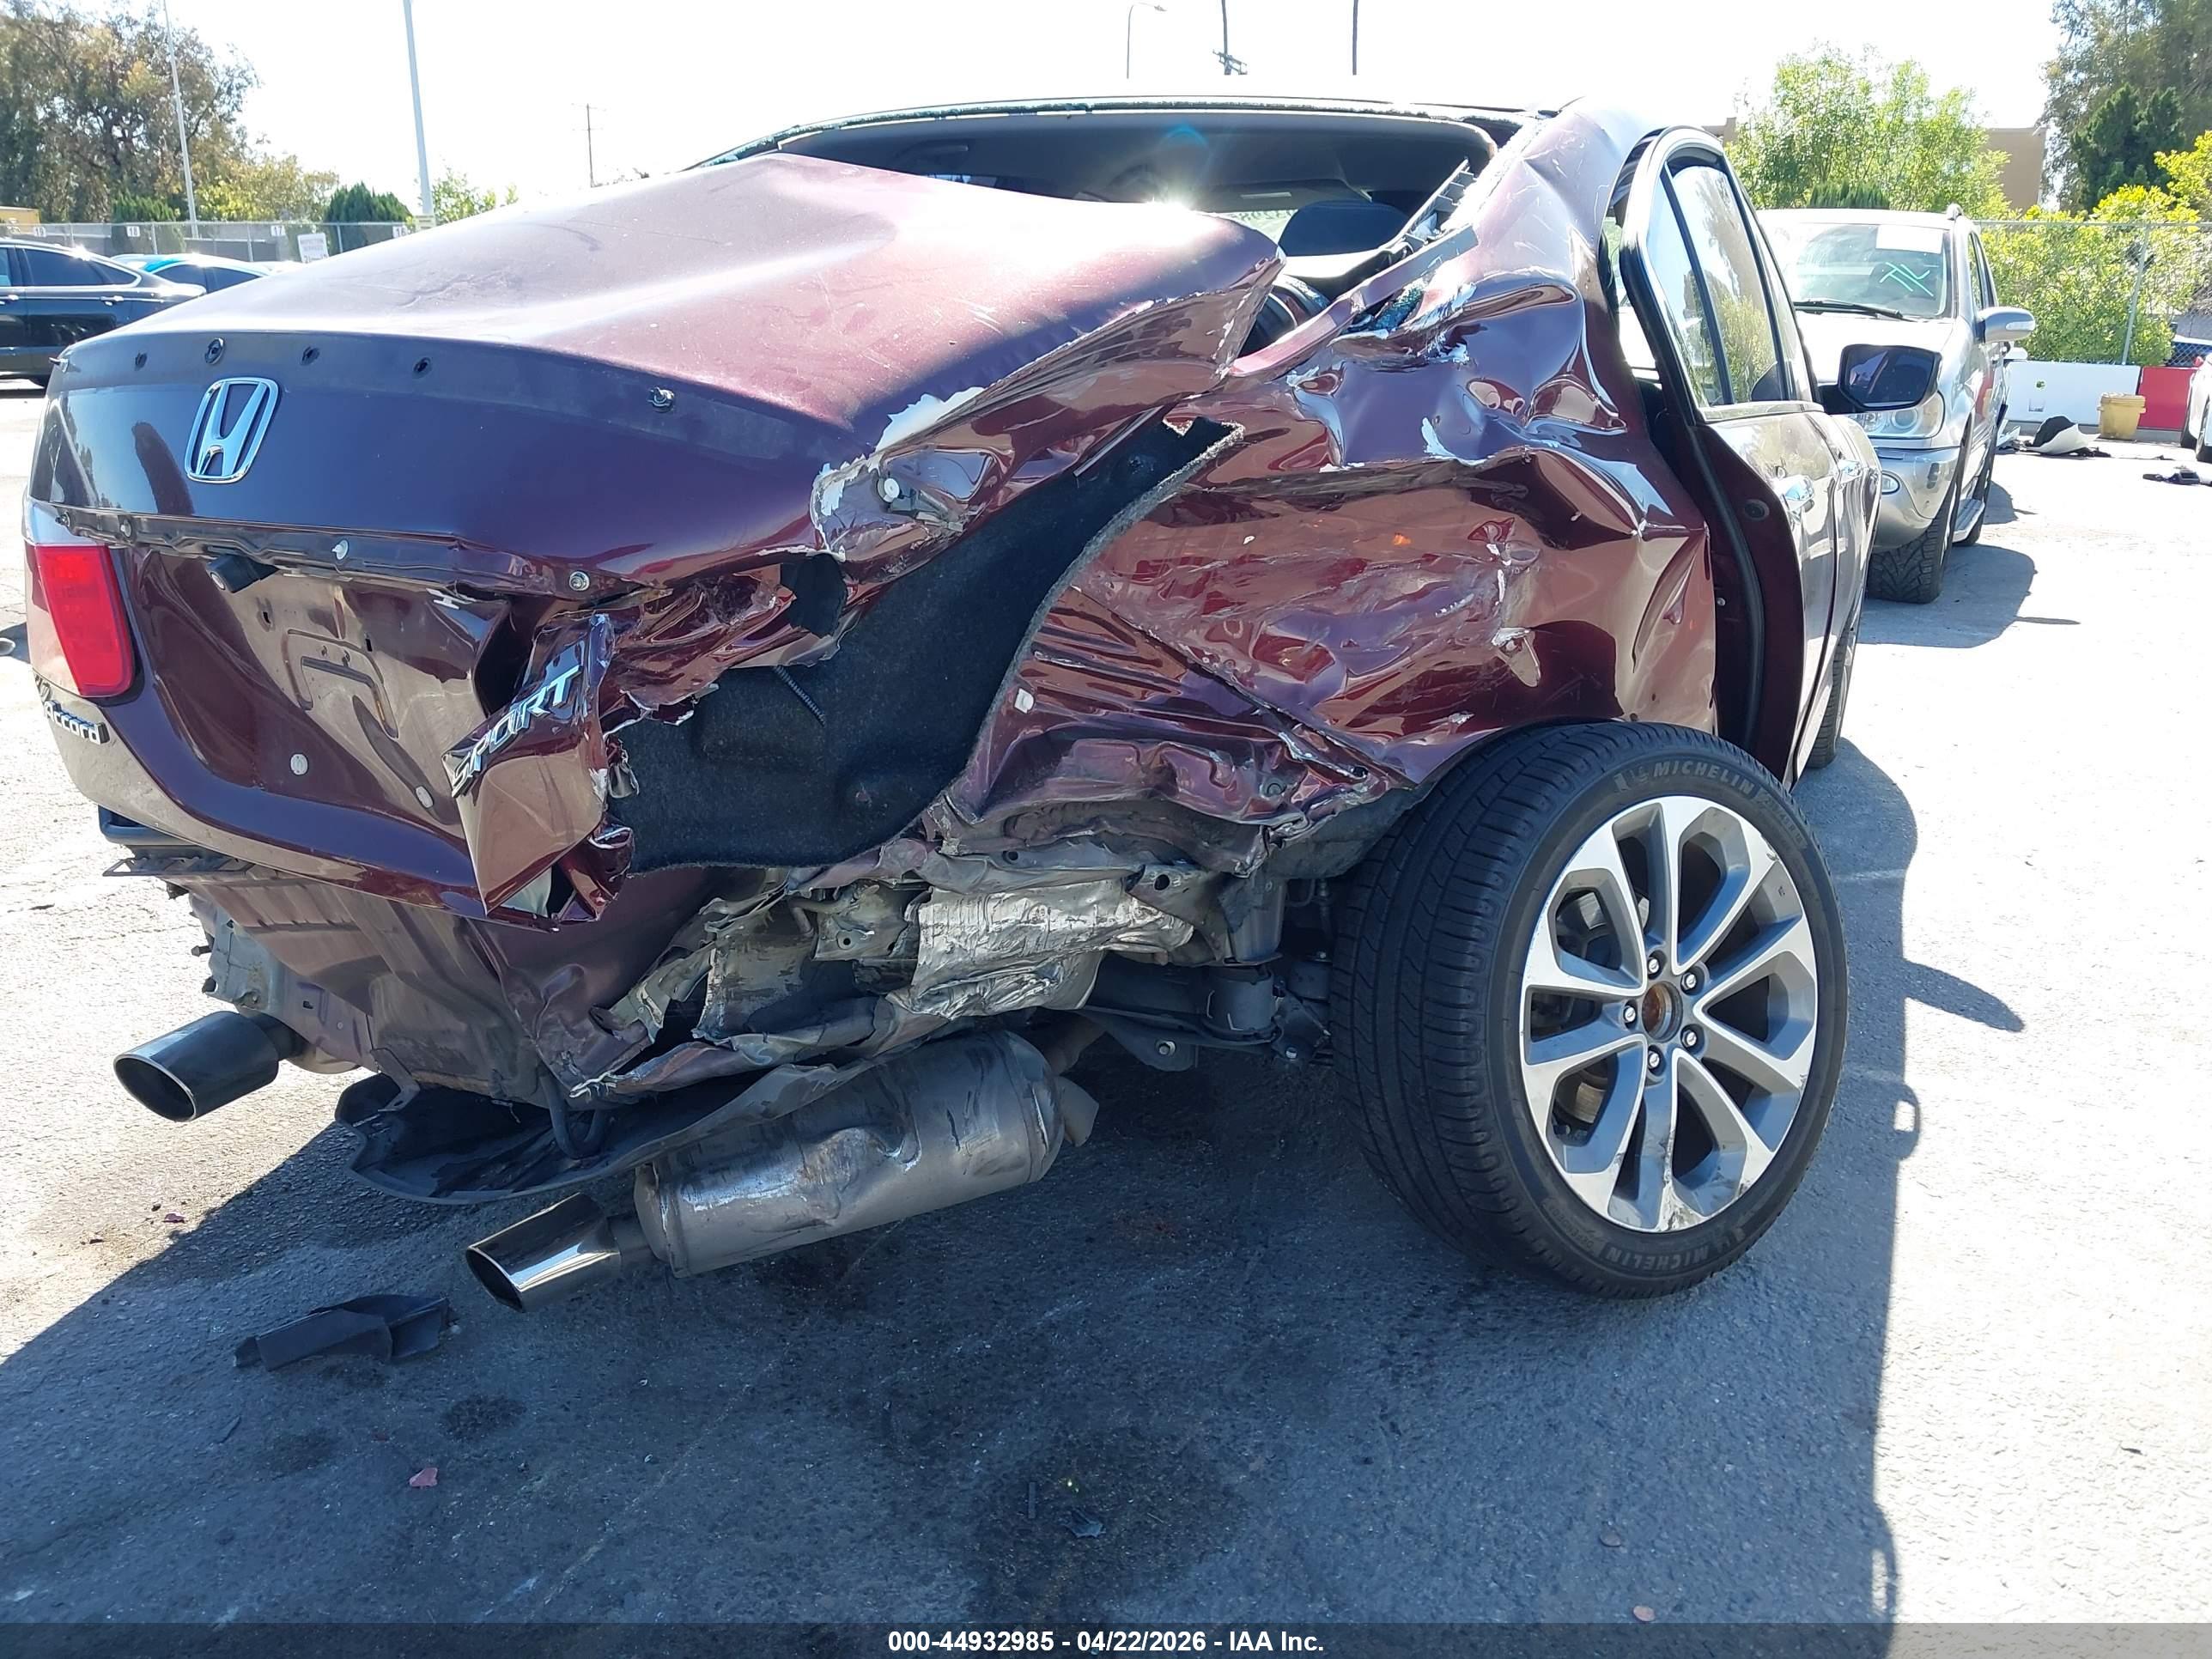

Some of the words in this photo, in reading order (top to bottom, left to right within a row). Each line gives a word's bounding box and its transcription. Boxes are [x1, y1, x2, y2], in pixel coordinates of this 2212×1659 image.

[44, 700, 109, 745] Accord
[451, 665, 583, 799] SPORT
[1654, 760, 1755, 796] MICHELIN
[1604, 1245, 1711, 1272] MICHELIN
